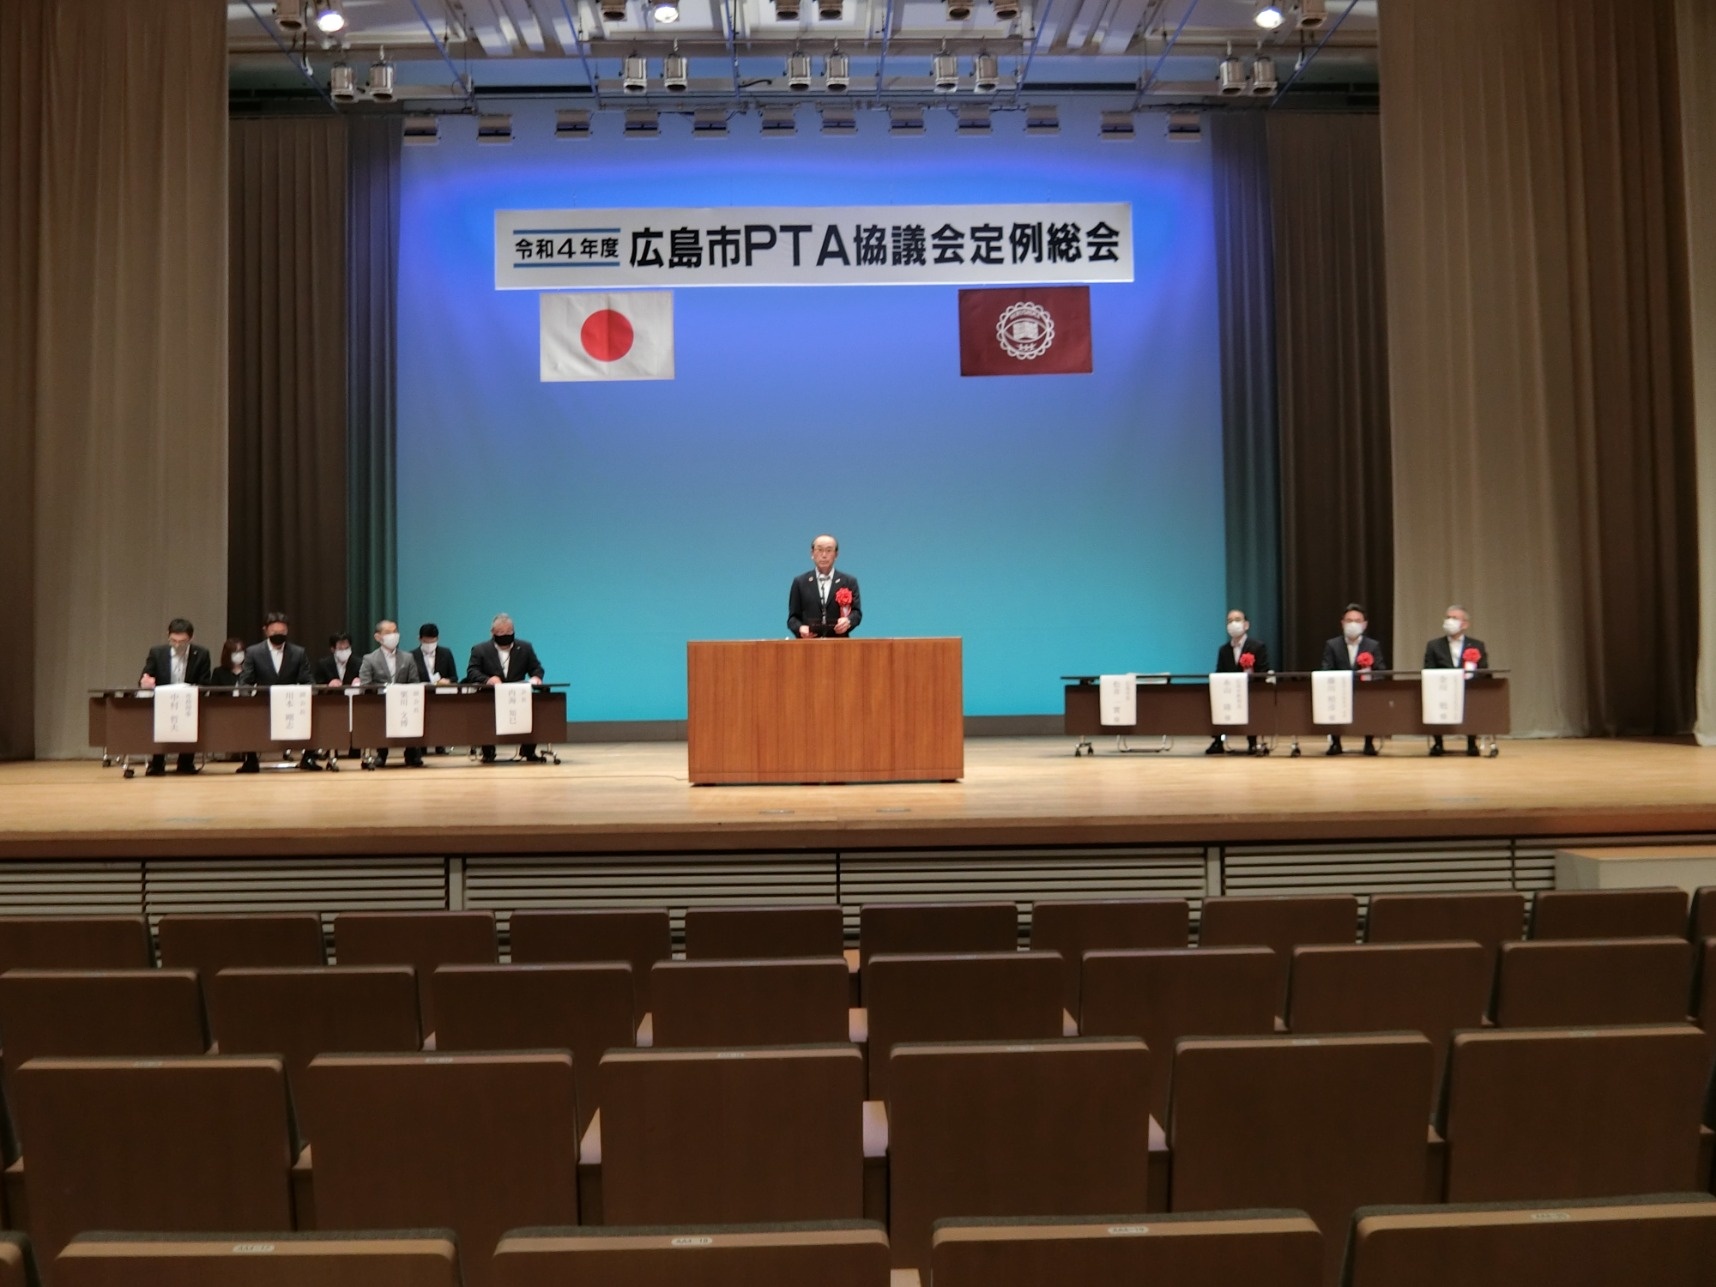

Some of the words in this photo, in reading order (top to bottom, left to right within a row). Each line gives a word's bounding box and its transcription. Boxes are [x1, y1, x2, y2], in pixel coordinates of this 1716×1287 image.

[514, 237, 620, 260] 令和4年度
[629, 221, 1120, 269] 広島市PTA協議会定例総会
